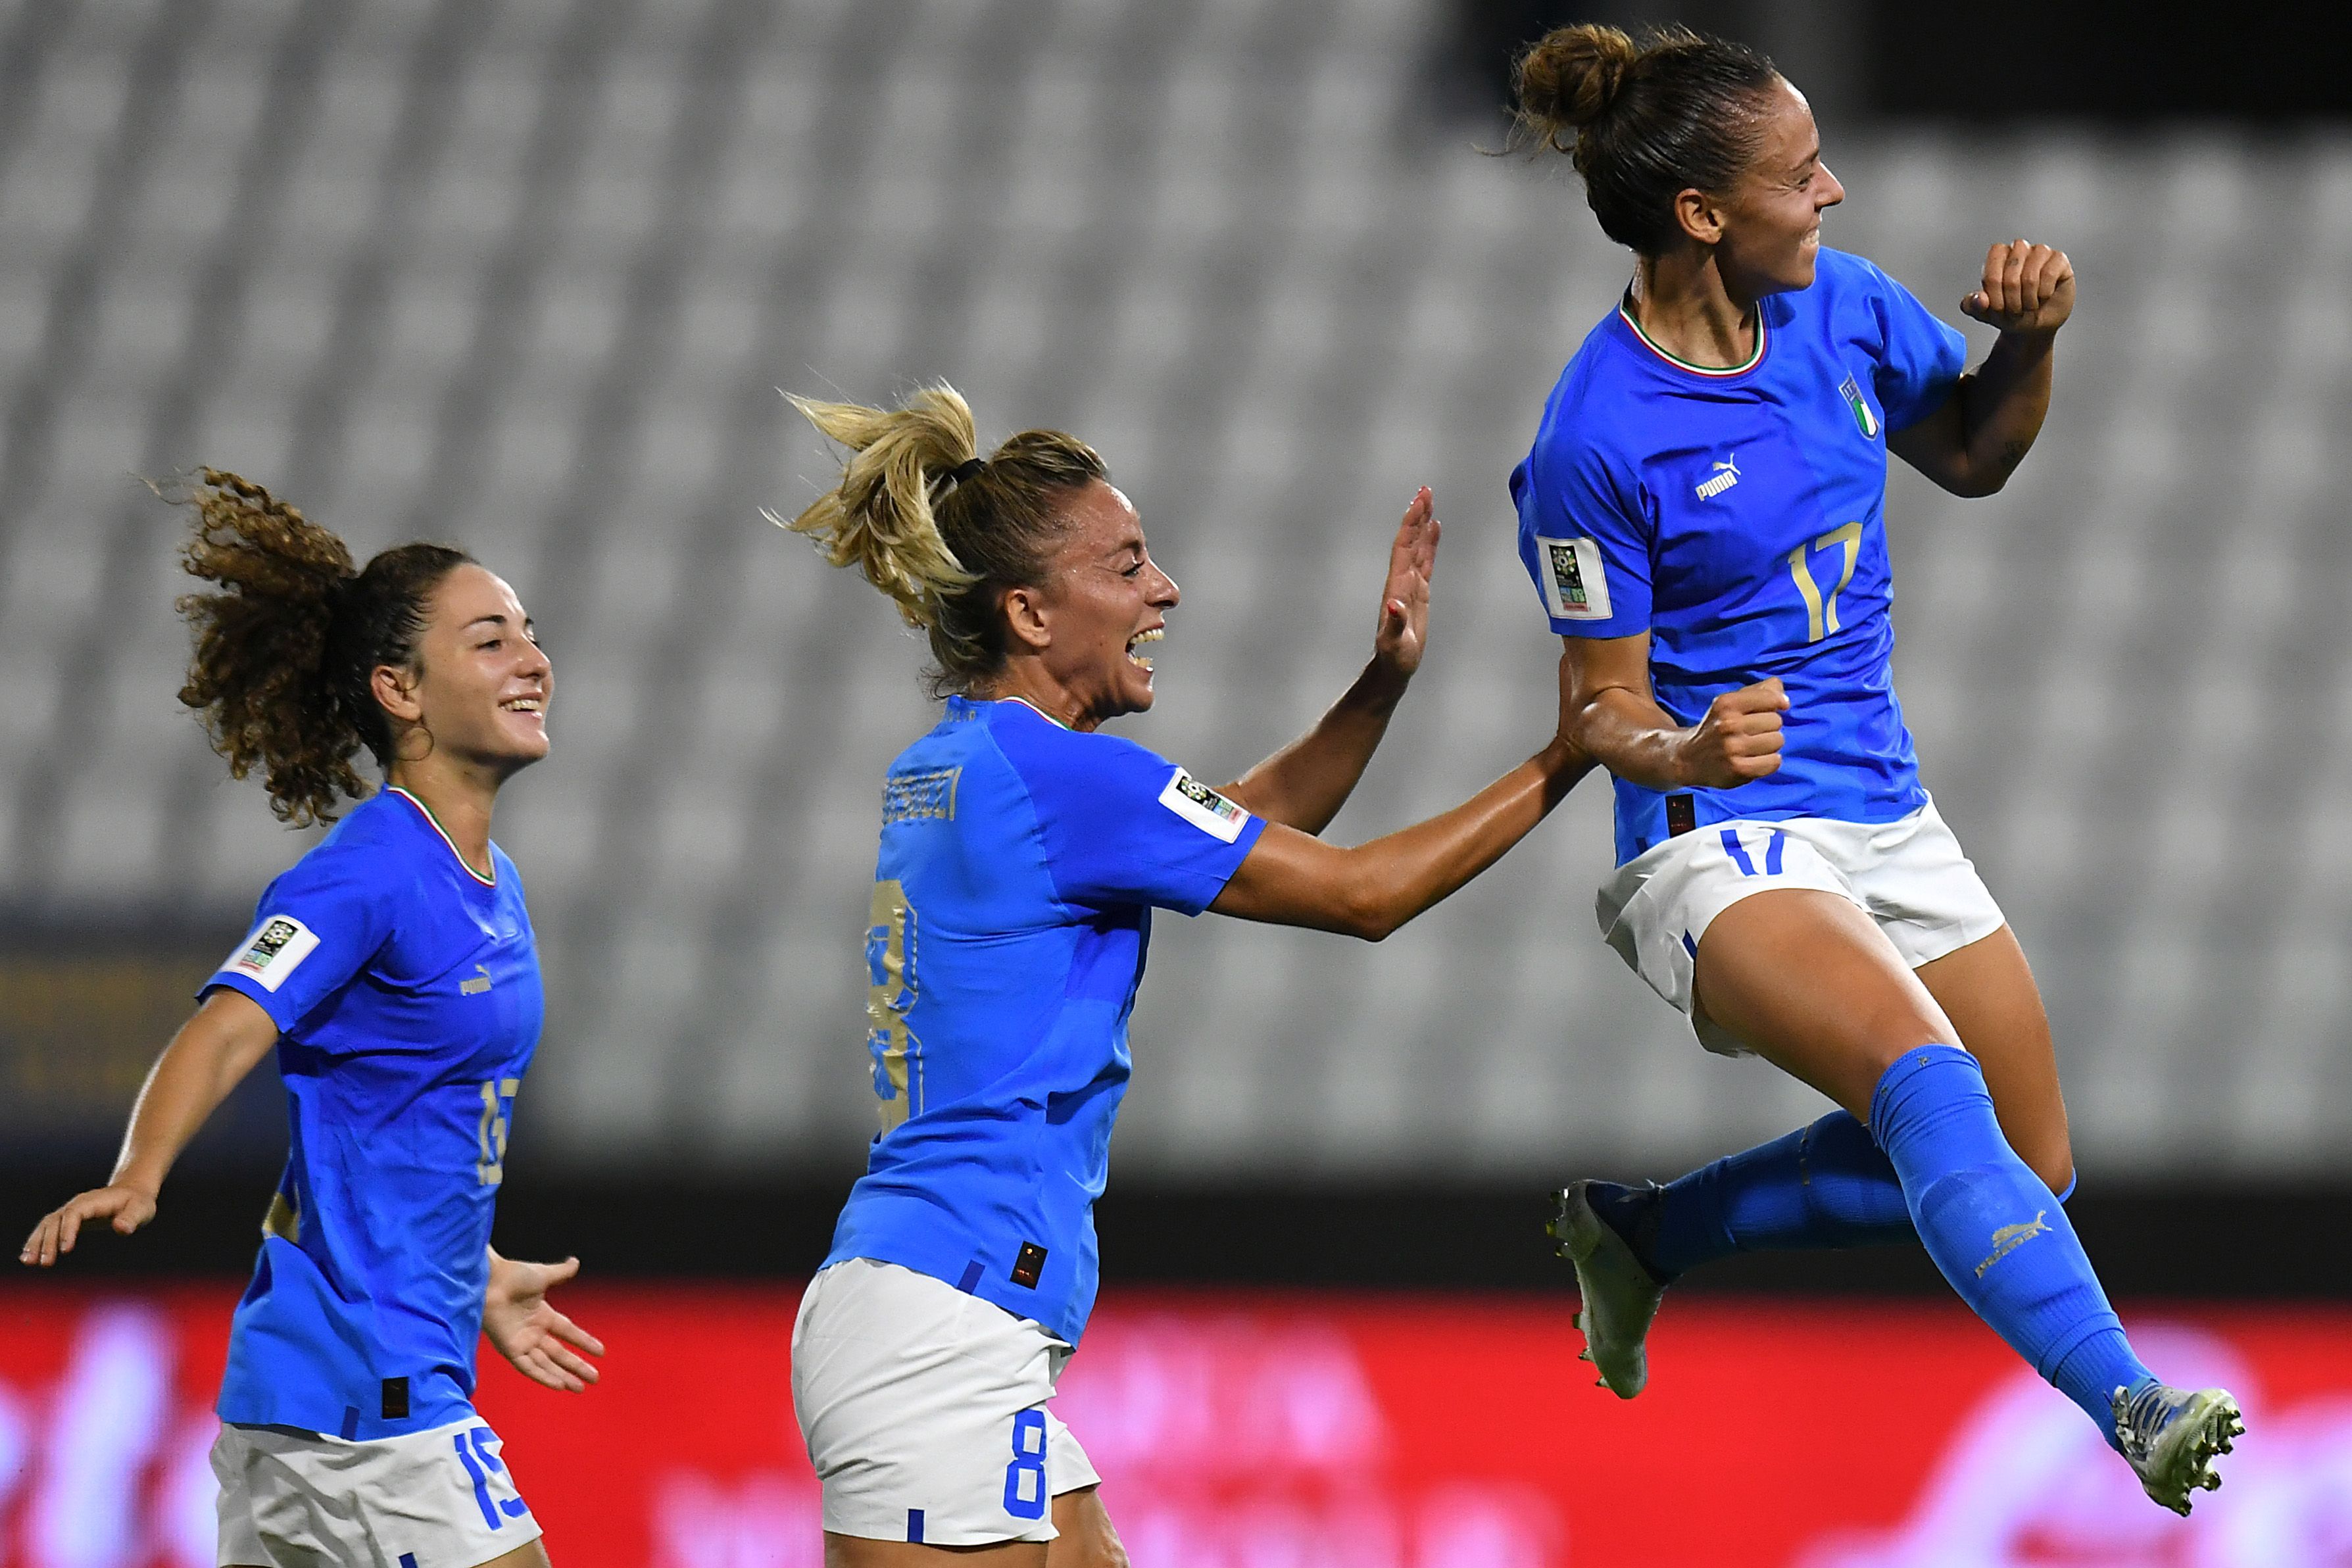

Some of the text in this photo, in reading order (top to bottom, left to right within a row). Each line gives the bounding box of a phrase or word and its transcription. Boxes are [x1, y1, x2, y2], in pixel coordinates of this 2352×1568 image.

[1696, 470, 1738, 501] PUMA
[1788, 521, 1863, 643] 17
[453, 1427, 529, 1531] 15
[1003, 1408, 1047, 1520] 8
